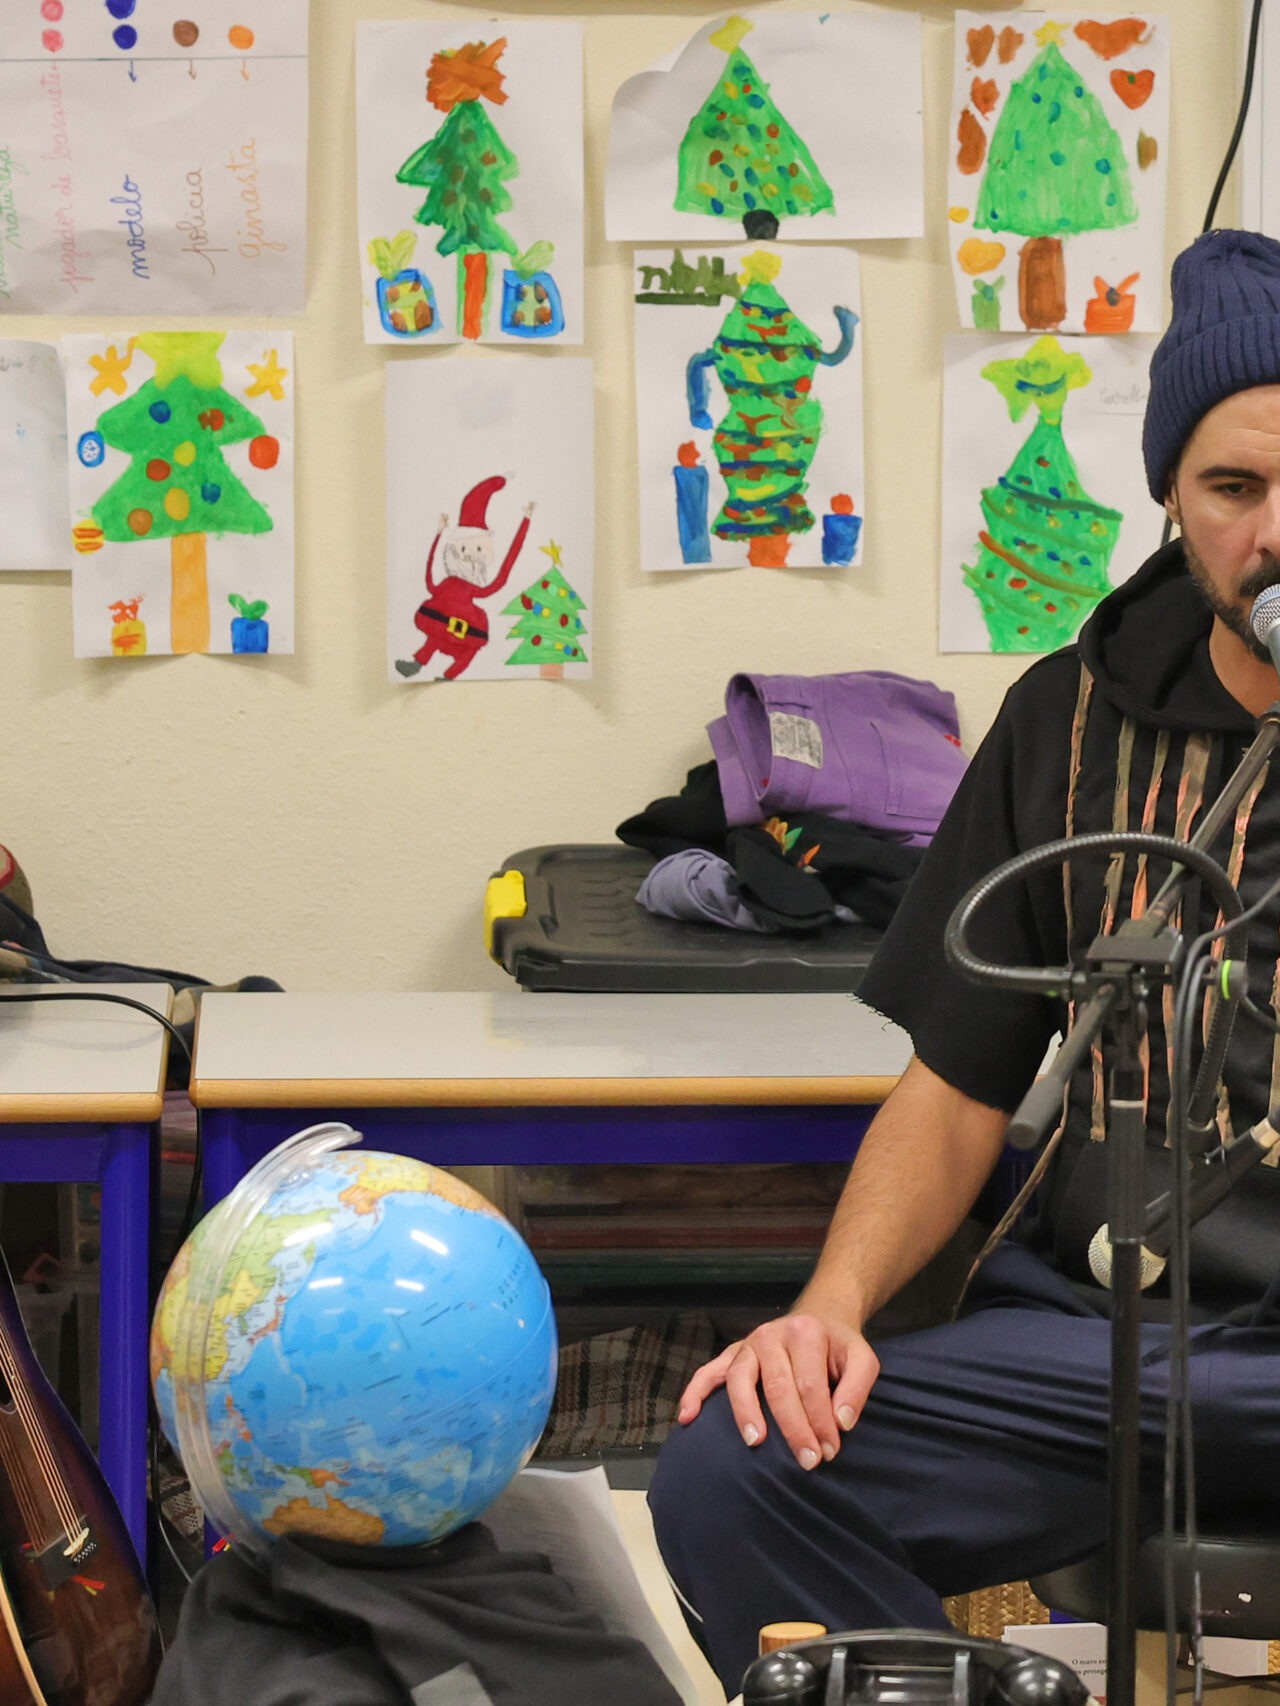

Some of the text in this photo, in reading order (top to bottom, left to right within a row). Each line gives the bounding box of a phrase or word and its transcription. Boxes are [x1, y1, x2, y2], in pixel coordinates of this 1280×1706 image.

[52, 203, 94, 293] jogador
[110, 174, 150, 279] modelo
[226, 137, 287, 258] ginasta
